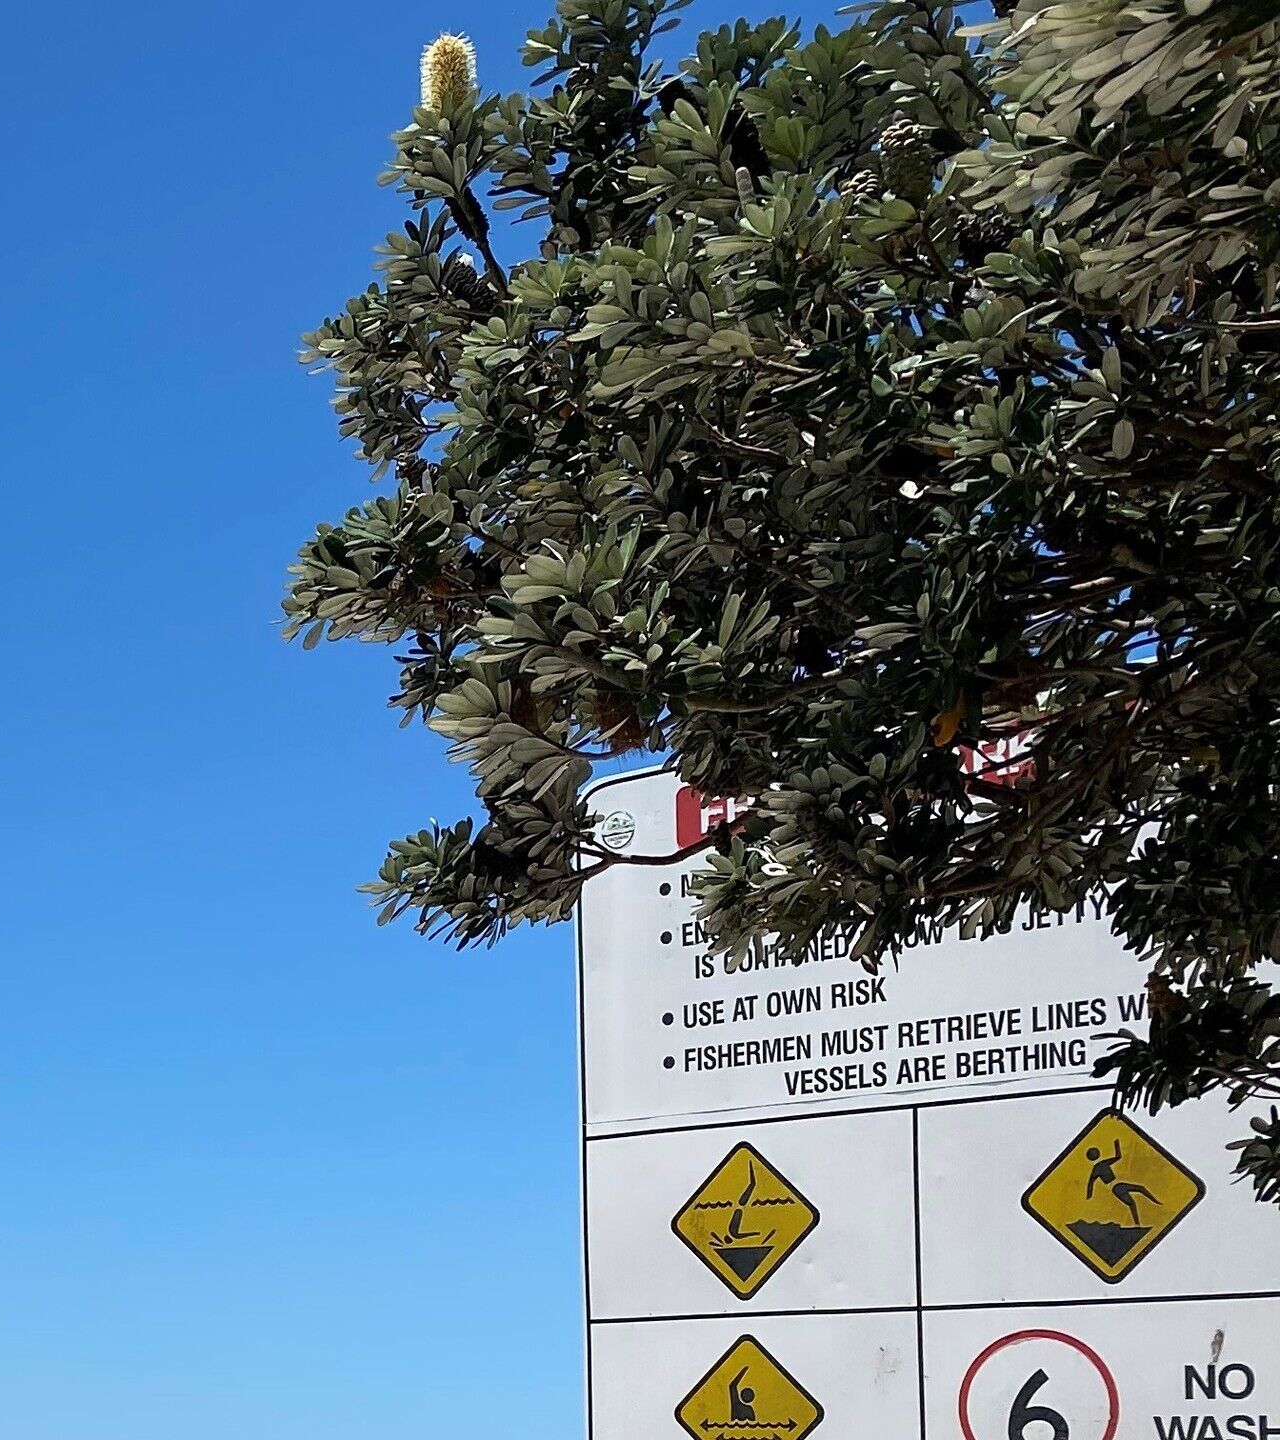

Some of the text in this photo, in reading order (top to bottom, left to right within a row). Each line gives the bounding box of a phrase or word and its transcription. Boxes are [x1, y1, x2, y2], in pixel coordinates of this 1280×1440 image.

[695, 954, 714, 979] IS
[724, 932, 849, 975] CONTNED
[683, 977, 887, 1028] USE AT OWN RISK
[684, 1034, 812, 1072] FISHERMEN
[821, 1025, 889, 1057] MUST
[898, 1008, 1022, 1048] RETRIEVE
[1032, 998, 1107, 1033] LINES
[784, 1039, 1086, 1095] VESSELS ARE BERTHING
[1184, 1363, 1255, 1400] NO
